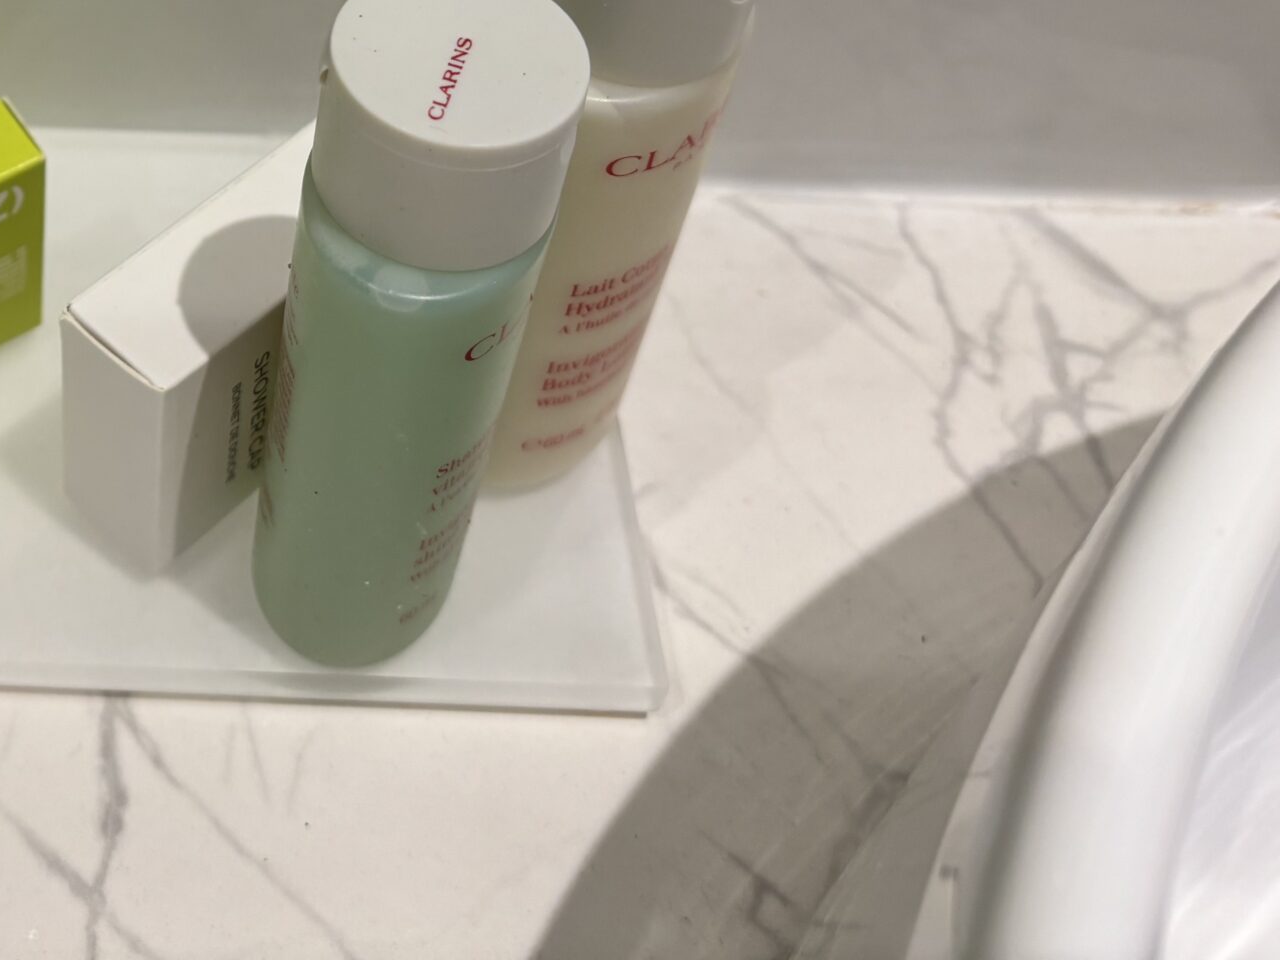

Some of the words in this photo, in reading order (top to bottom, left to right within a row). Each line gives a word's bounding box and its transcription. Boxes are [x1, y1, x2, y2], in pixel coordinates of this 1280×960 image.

[427, 36, 473, 121] CLARINS
[571, 277, 615, 297] Lait
[251, 351, 270, 432] SHOWER
[248, 435, 265, 470] CAP
